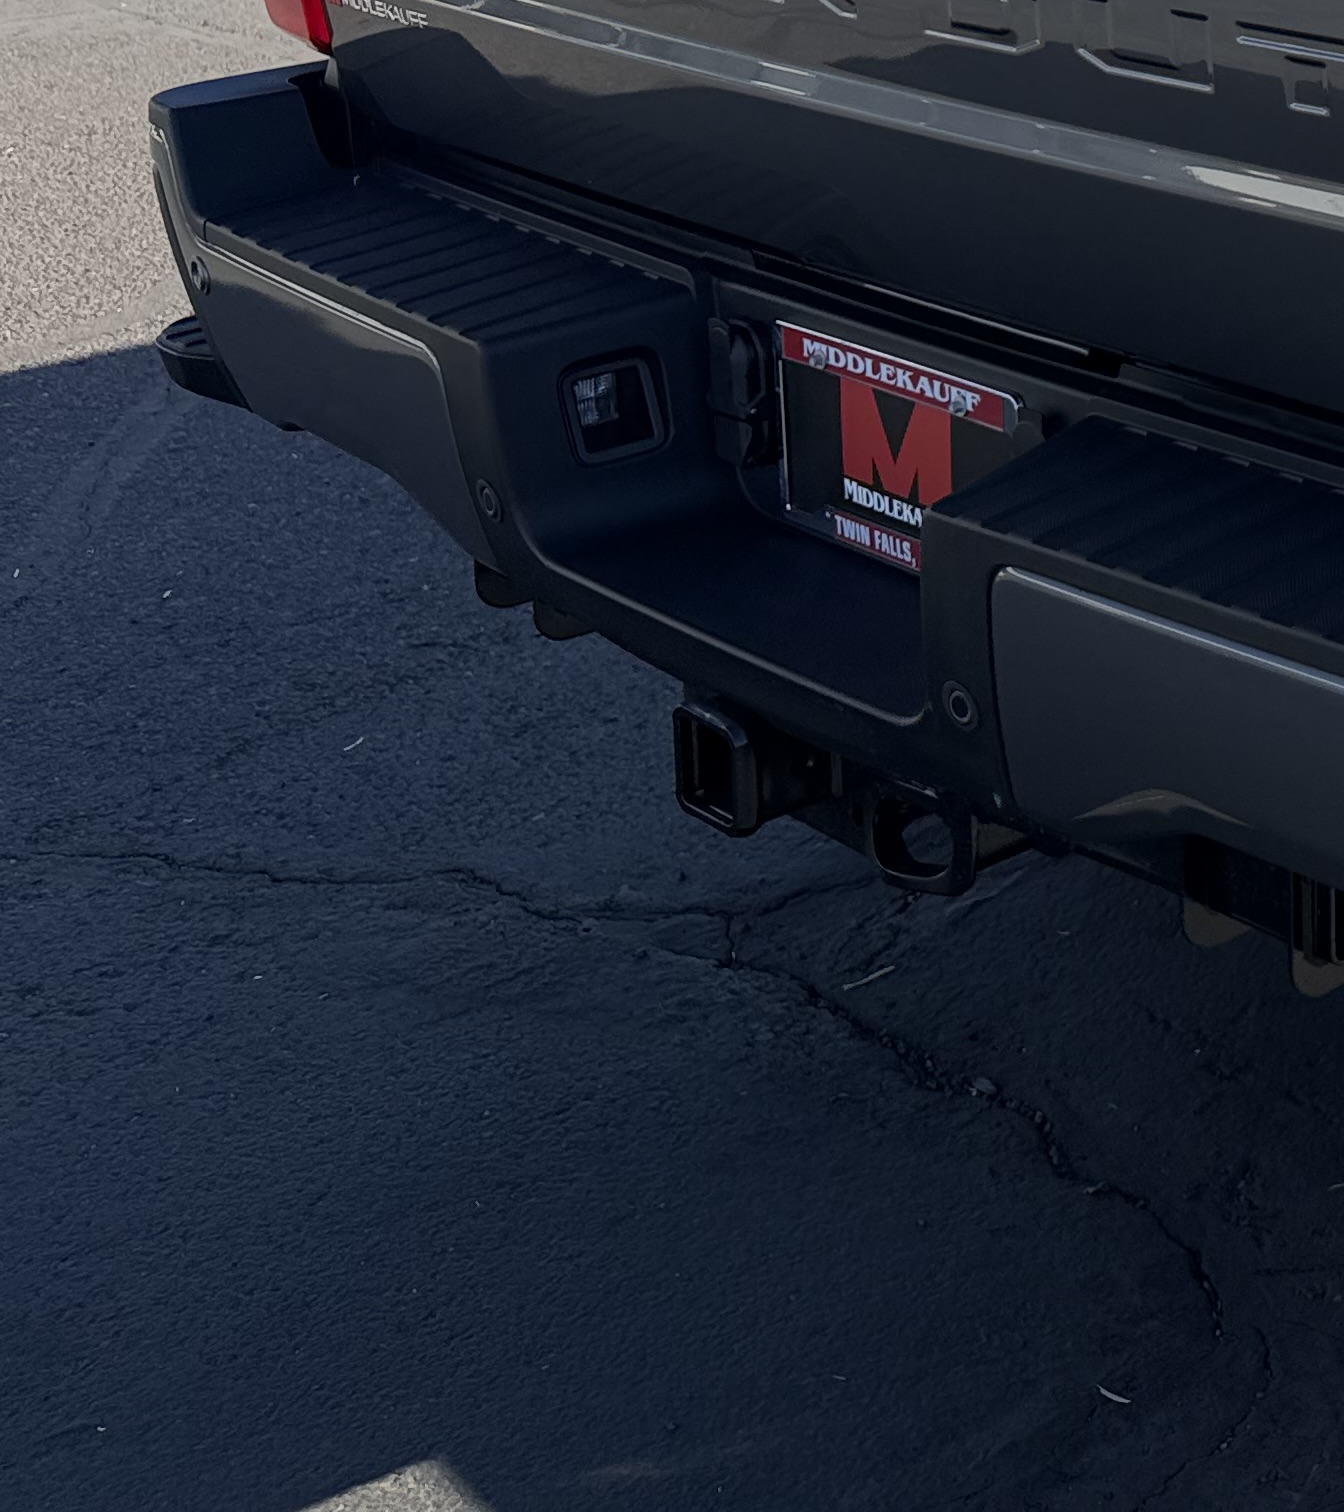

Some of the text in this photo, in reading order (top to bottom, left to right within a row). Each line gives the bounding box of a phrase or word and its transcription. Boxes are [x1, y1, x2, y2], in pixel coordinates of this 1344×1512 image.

[802, 337, 982, 414] MIDDLEKAUFF
[840, 376, 953, 506] M
[843, 477, 923, 528] MIDDLEKA
[834, 514, 917, 568] TWIN FALLS,
